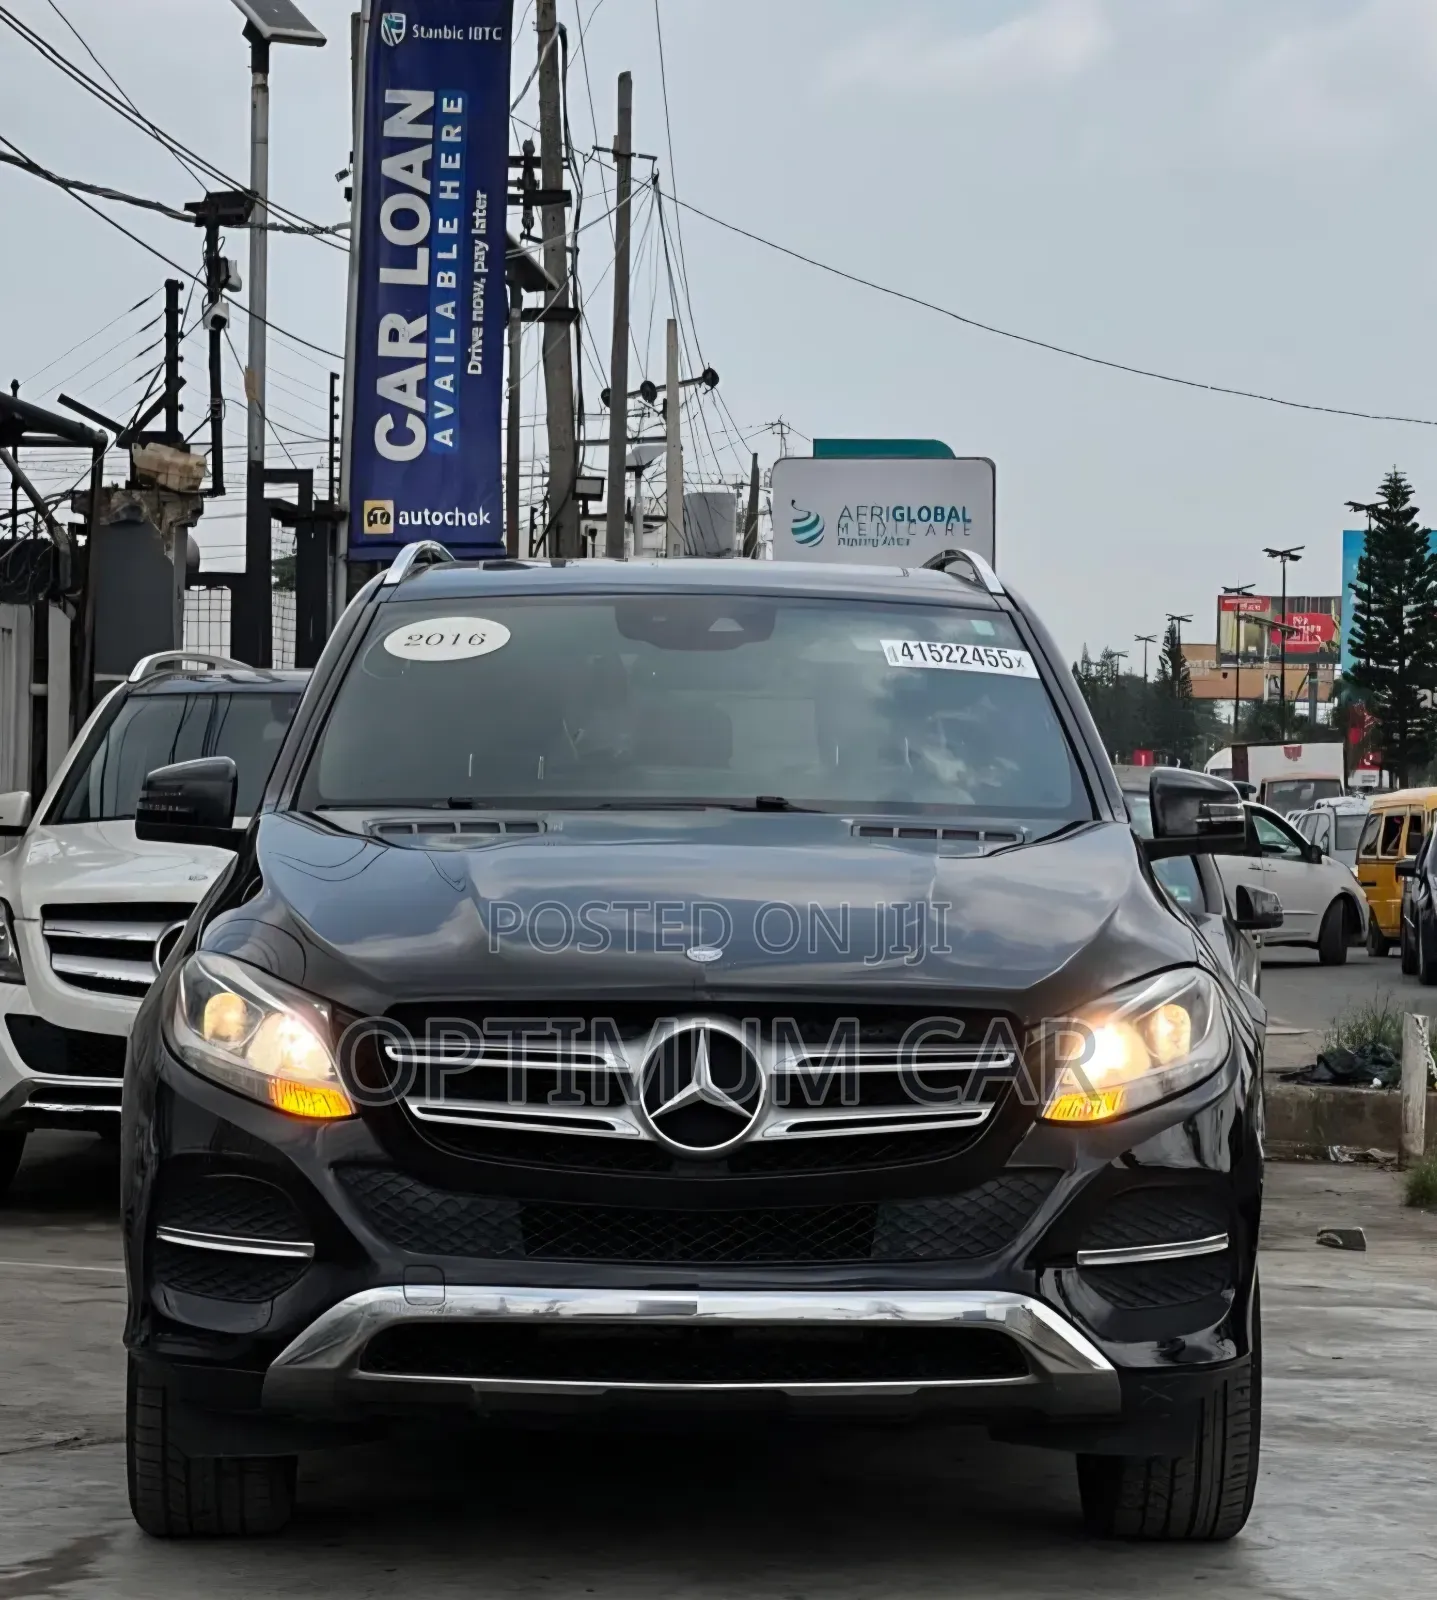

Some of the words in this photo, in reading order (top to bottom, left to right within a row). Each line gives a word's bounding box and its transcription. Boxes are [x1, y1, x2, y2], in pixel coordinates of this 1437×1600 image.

[412, 23, 464, 40] Stanbic
[468, 26, 503, 41] IBTC
[438, 97, 463, 200] HERE
[379, 89, 435, 286] LOAN
[471, 190, 488, 235] later
[473, 239, 489, 273] pay
[433, 217, 459, 448] AVAILABLE
[467, 327, 484, 375] Drive
[374, 313, 429, 462] CAR
[398, 506, 491, 527] autochek
[837, 504, 972, 523] AFRIGLOBAL
[837, 522, 972, 537] MEDICARE
[404, 632, 487, 647] 2016
